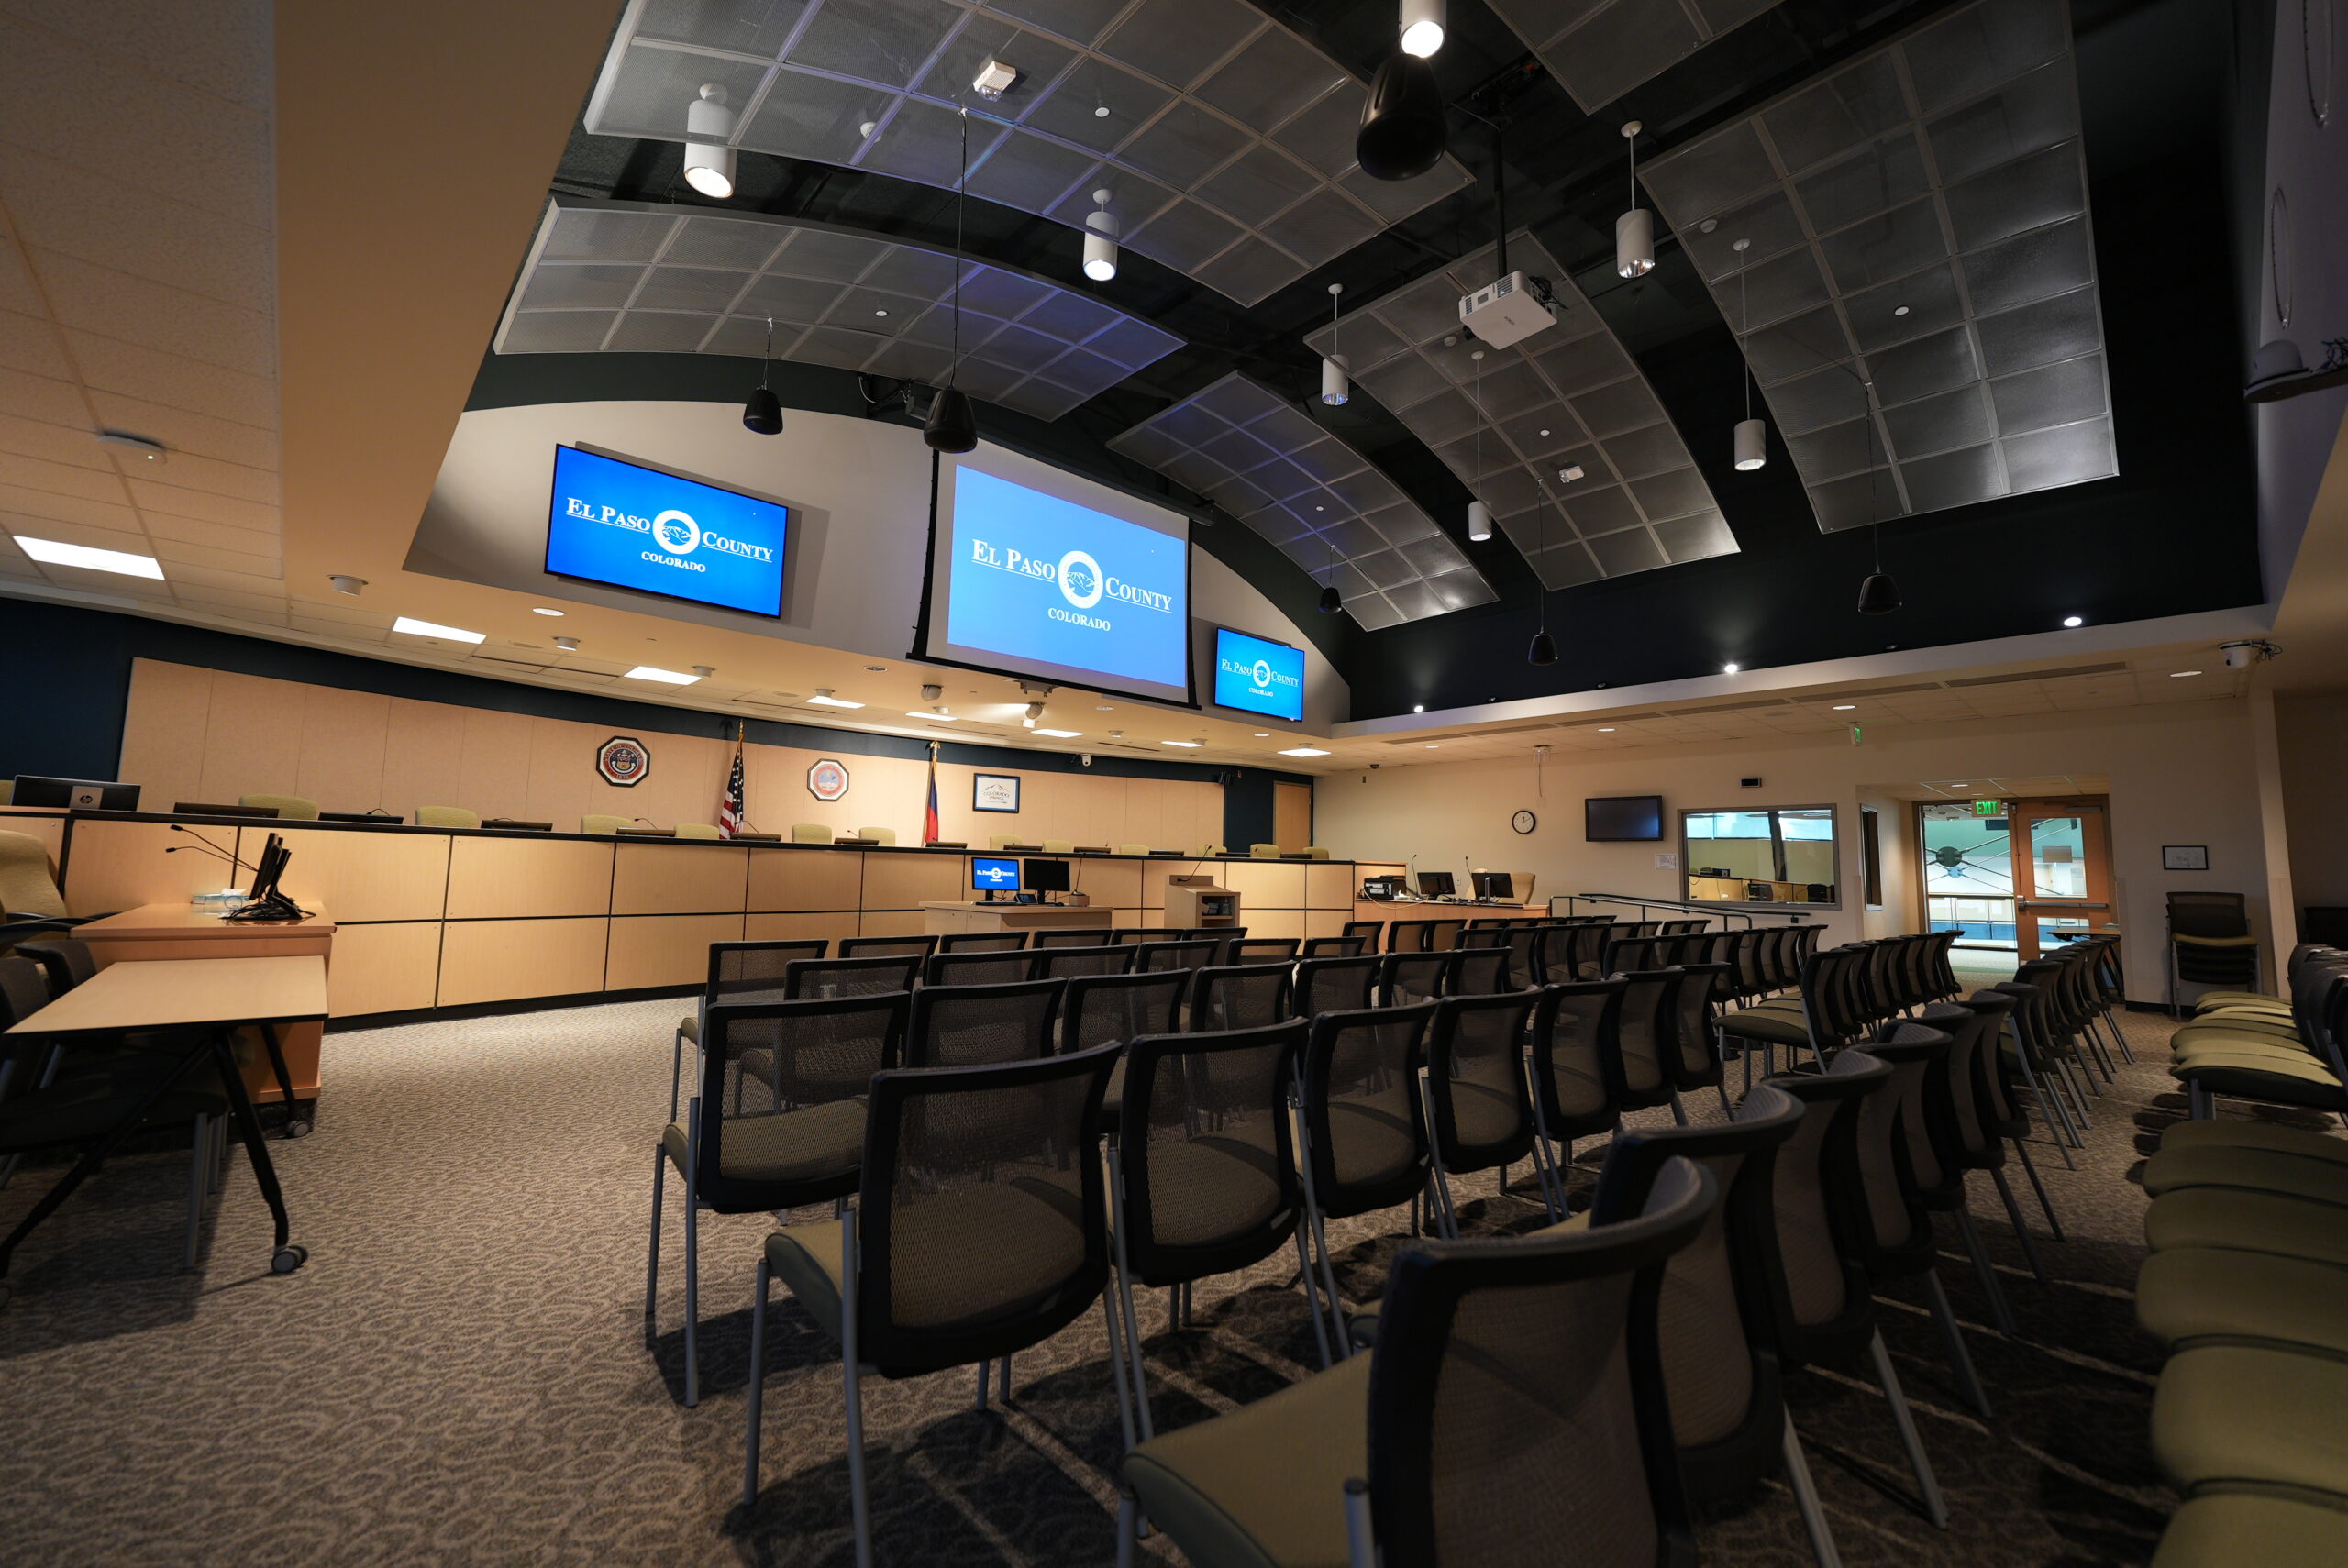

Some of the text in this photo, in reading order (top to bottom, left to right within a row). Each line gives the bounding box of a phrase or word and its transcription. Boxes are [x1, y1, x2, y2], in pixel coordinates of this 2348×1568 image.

[566, 497, 773, 561] EL PASO COUNTY
[641, 551, 706, 572] COLORADO
[971, 538, 1172, 611] EL PASO COUNTY
[1047, 607, 1111, 632] COLORADO
[1221, 658, 1299, 686] EL PASO COUNTY
[1248, 687, 1274, 697] COLORADO
[1976, 801, 1999, 815] EXIT
